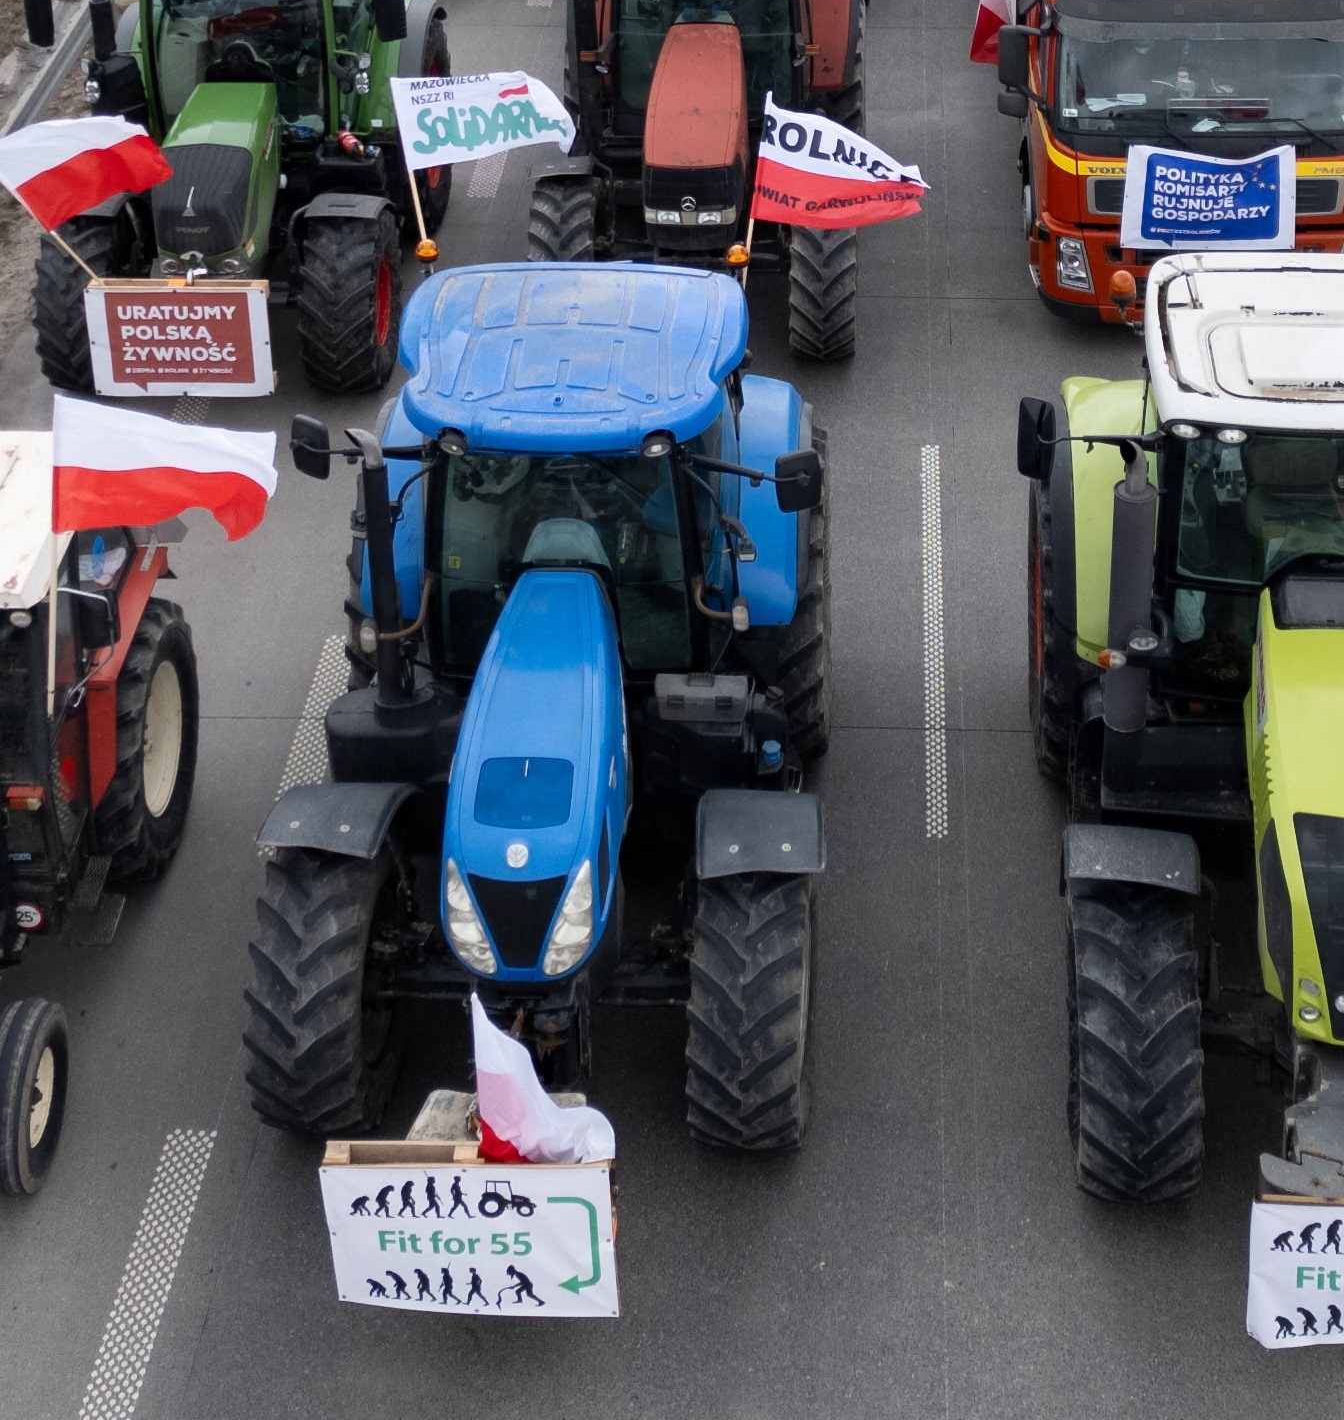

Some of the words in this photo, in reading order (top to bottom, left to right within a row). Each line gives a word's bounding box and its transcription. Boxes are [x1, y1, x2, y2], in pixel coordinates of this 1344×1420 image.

[410, 74, 490, 91] MAZOWIECKA
[411, 93, 441, 106] NSZZ
[443, 90, 455, 101] RI
[761, 114, 922, 184] ROLNIC
[1087, 166, 1126, 175] VOLV
[1155, 165, 1245, 184] POLITYKA
[1154, 180, 1247, 197] KOMISARZY
[1153, 194, 1234, 211] RUJNUJE
[1152, 206, 1271, 222] GOSPODARZY
[116, 305, 236, 320] URATUJMY
[120, 325, 213, 344] POLSKĄ
[122, 342, 237, 362] ŻYWNOŚĆ
[16, 910, 33, 923] 25
[378, 1230, 422, 1254] Fit
[429, 1230, 481, 1255] for
[490, 1232, 533, 1256] 55
[1296, 1266, 1341, 1291] Fit
